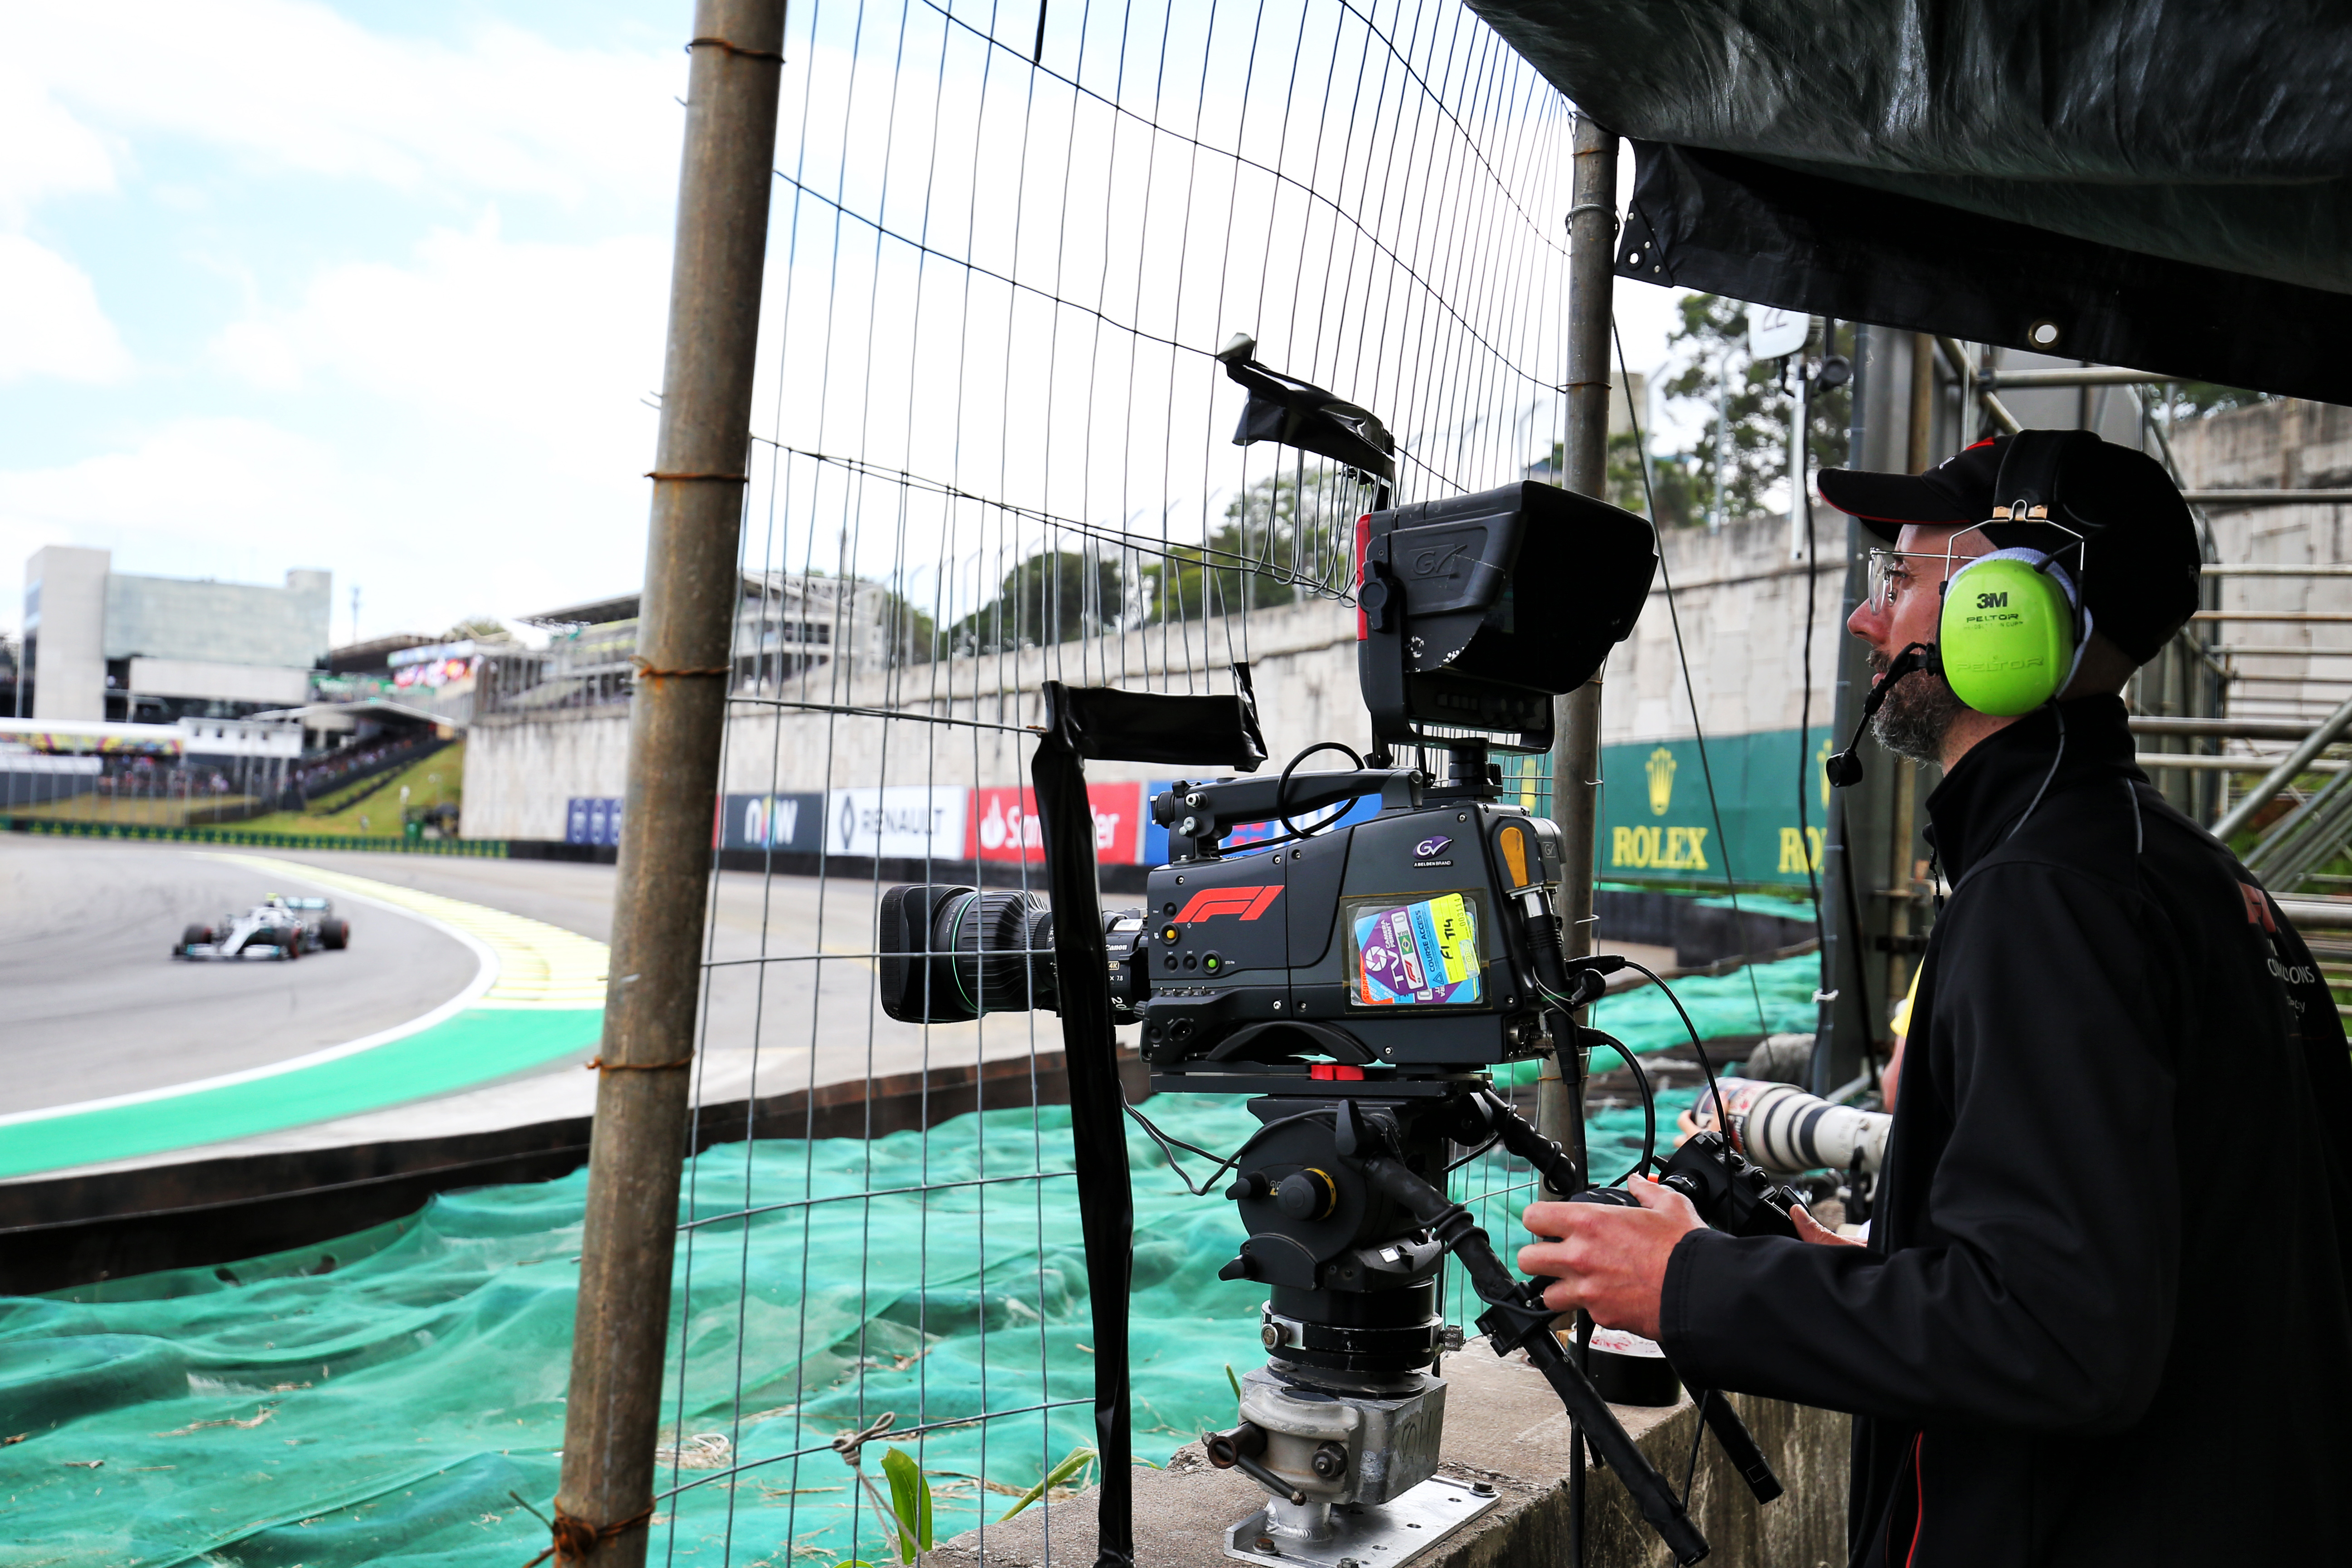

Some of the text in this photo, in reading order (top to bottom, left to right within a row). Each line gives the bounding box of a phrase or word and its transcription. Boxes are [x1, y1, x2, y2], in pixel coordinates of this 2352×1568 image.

[1976, 592, 2008, 609] 3M
[1966, 613, 2019, 623] PELTOR
[1956, 657, 2044, 672] PELTOR
[862, 807, 946, 835] RENAULT
[1611, 825, 1709, 871] ROLEX
[1171, 885, 1284, 923] F1
[1454, 898, 1466, 926] 003114
[1382, 919, 1392, 949] CAMERA
[1385, 922, 1396, 948] PERMIT
[1415, 910, 1427, 941] ACCESS
[1387, 950, 1404, 989] TV
[1405, 959, 1417, 983] F1
[1424, 944, 1436, 973] COURSE
[1111, 996, 1127, 1009] 20
